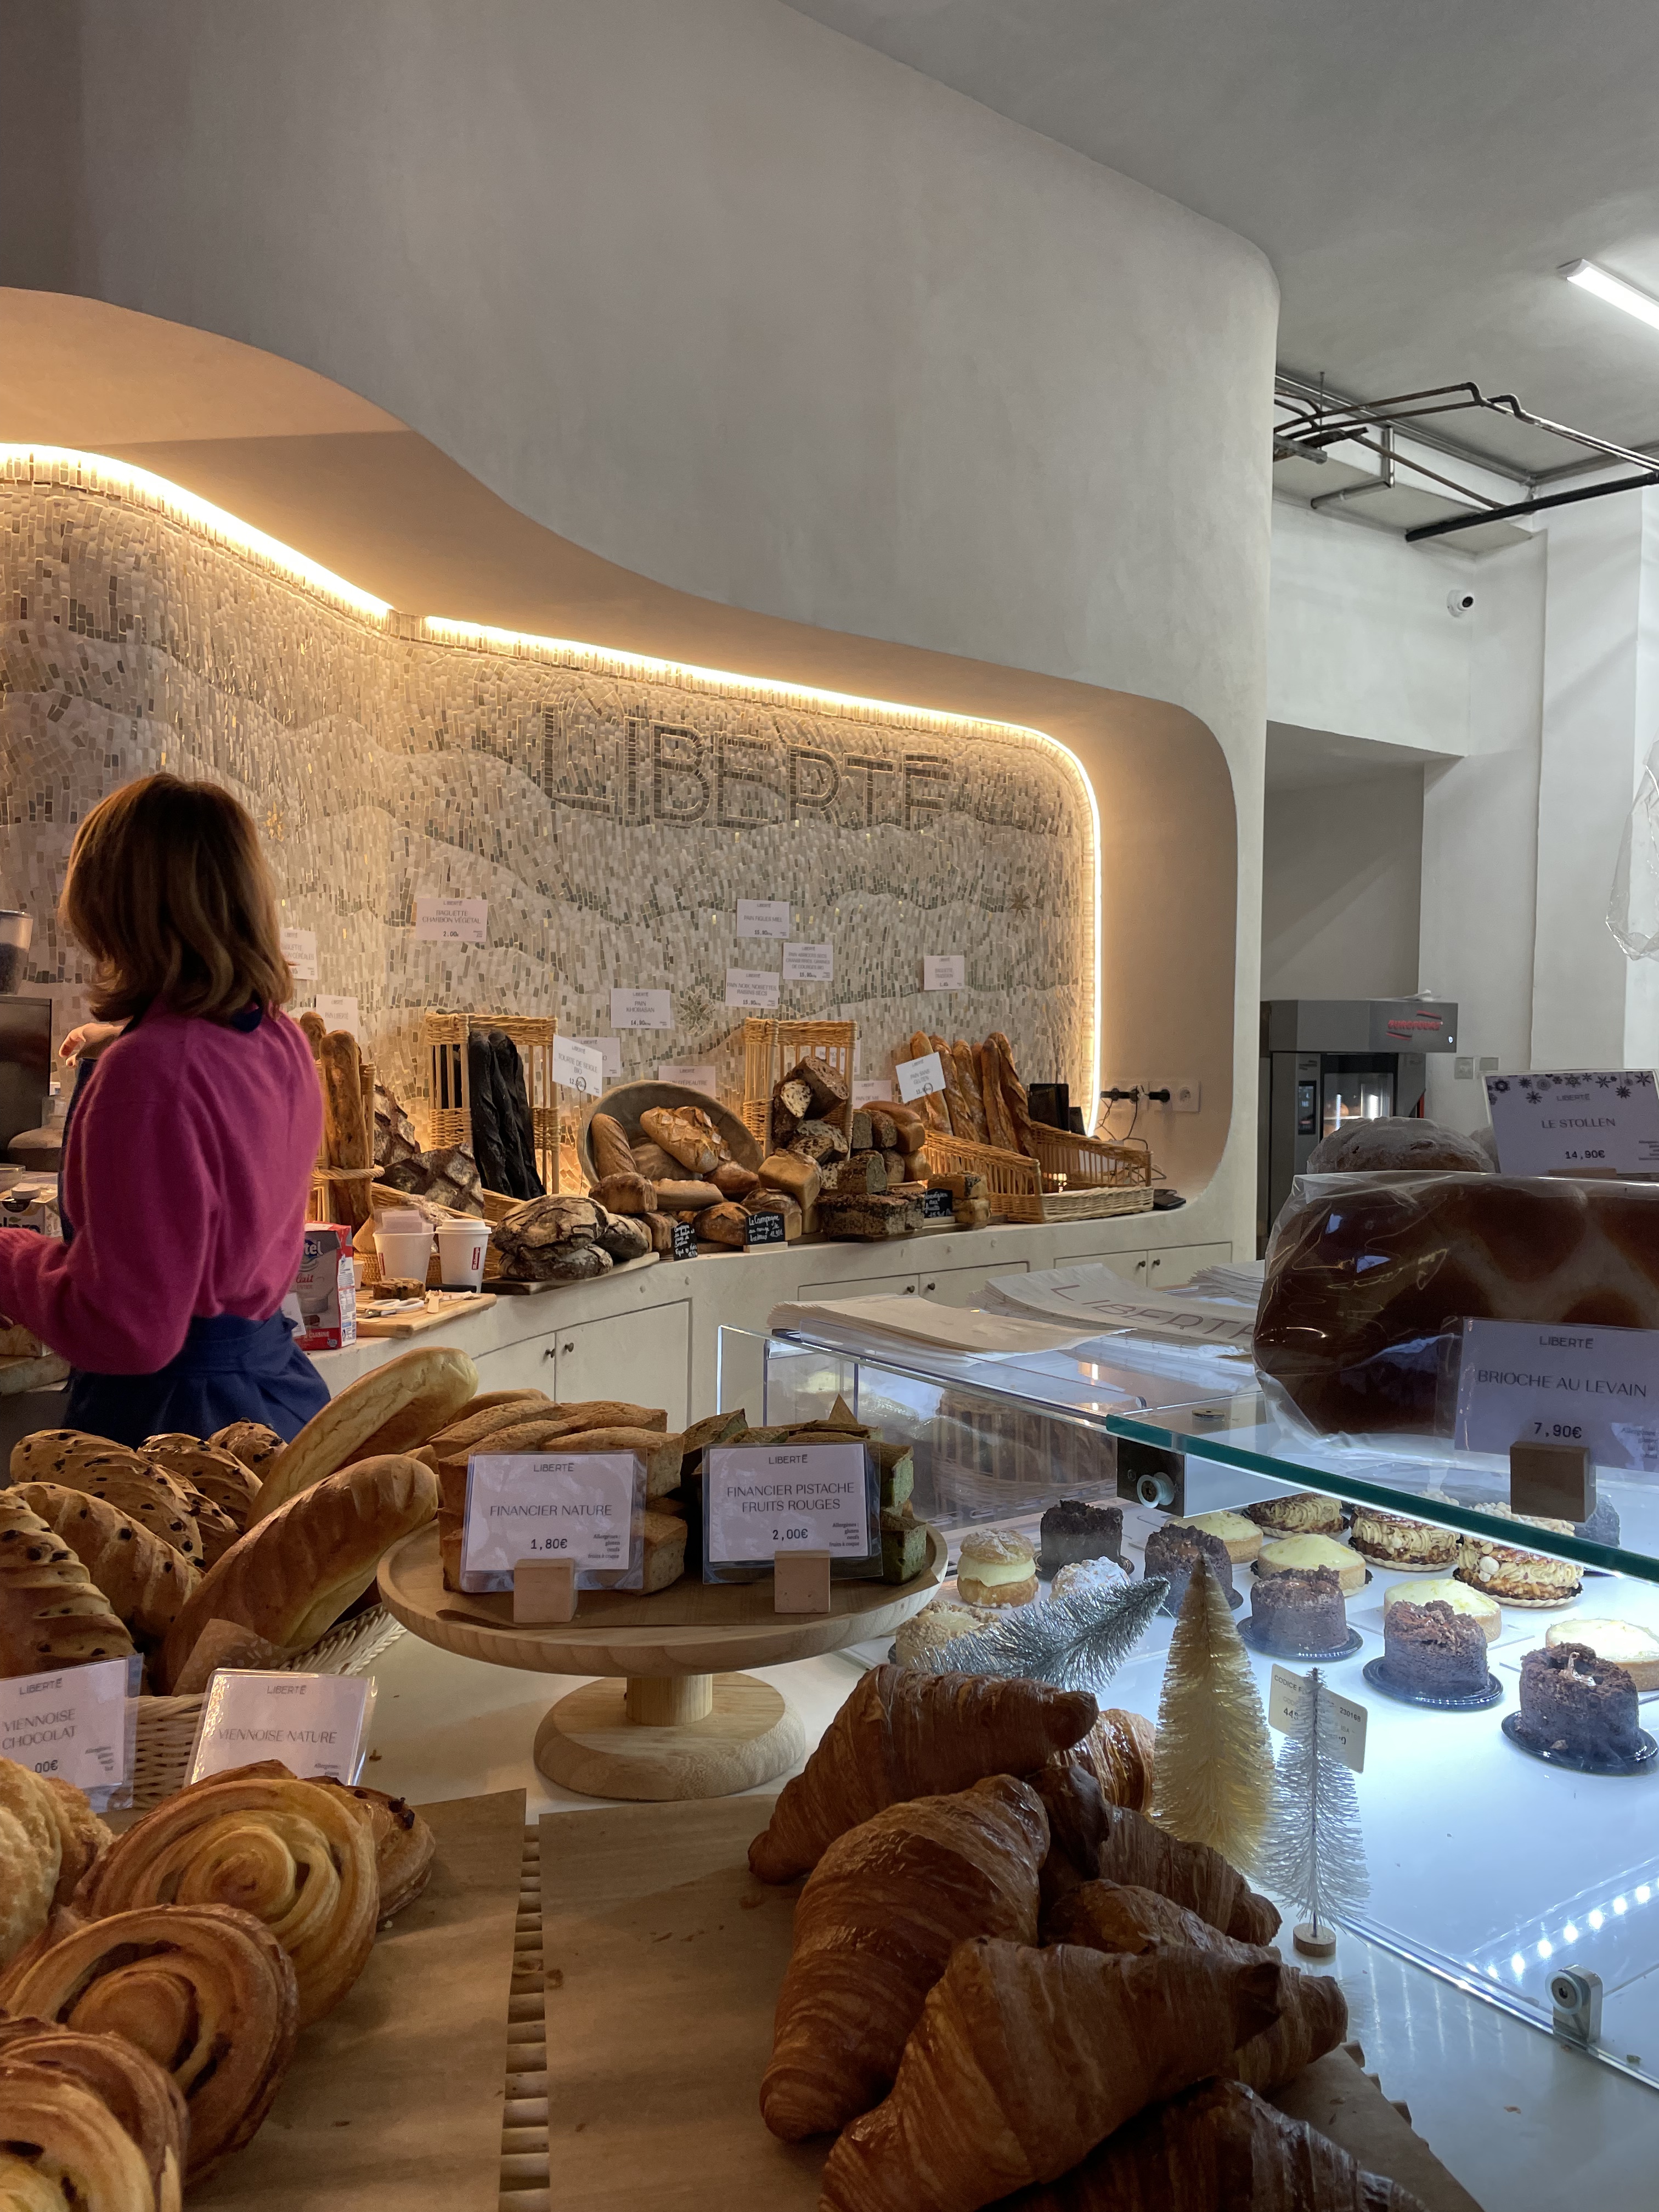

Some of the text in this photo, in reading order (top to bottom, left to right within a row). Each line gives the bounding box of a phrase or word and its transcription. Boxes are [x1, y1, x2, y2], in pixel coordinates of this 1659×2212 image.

[558, 1052, 575, 1064] TOURTE
[575, 1059, 582, 1068] DE
[583, 1062, 598, 1074] SEIGLE
[574, 1066, 582, 1075] BIO
[1542, 1118, 1616, 1128] LE STOLLEN
[1565, 1149, 1605, 1160] 14,90€
[304, 1240, 323, 1256] tel
[1478, 1369, 1646, 1397] BRIOCHE AU LEVAIN
[1534, 1422, 1582, 1438] 7,90€
[727, 1482, 855, 1497] FINANCIER PISTACHE
[490, 1504, 612, 1516] FINANCIER NATURE
[742, 1498, 840, 1513] FRUITS ROUGES
[772, 1528, 808, 1541] 2,00€
[530, 1538, 568, 1551] 1,80€
[1274, 1674, 1297, 1692] CODICE
[3, 1708, 77, 1732] VIENNOISE
[2, 1725, 77, 1750] CHOCOLAT
[218, 1728, 338, 1744] VIENNOISE NATURE
[35, 1759, 59, 1774] 00€
